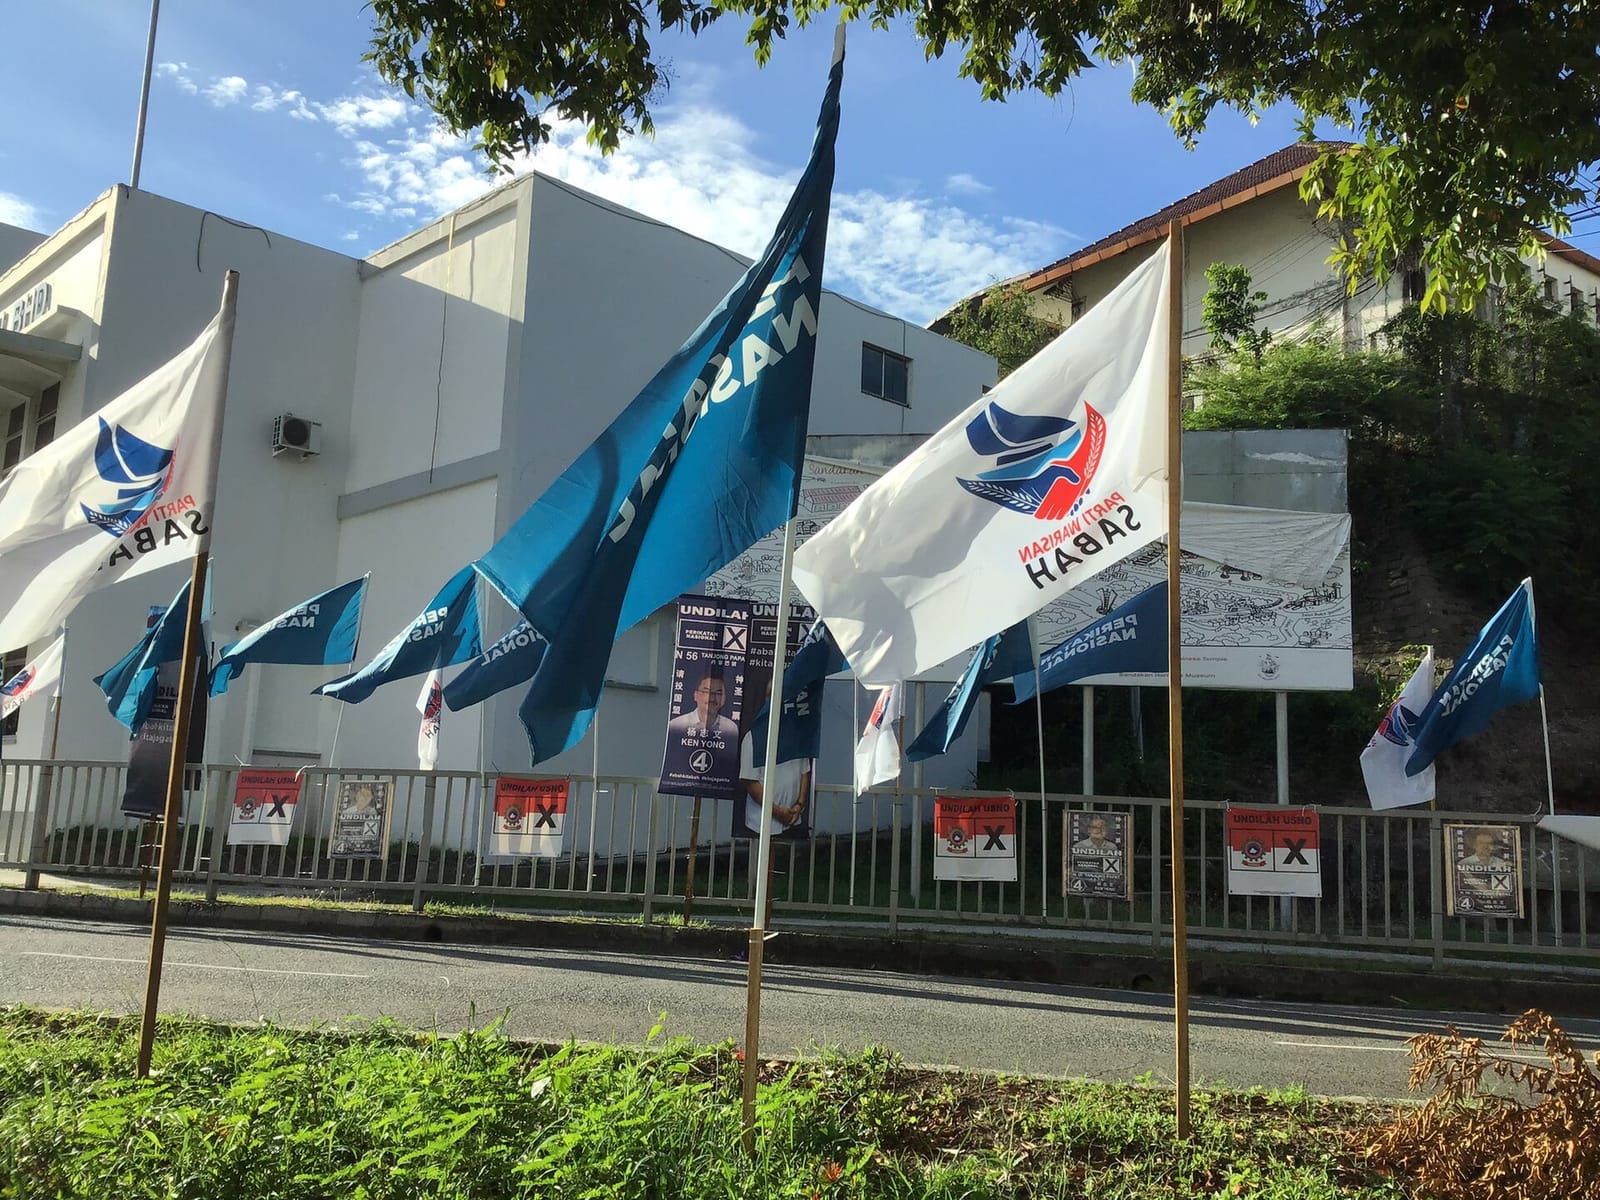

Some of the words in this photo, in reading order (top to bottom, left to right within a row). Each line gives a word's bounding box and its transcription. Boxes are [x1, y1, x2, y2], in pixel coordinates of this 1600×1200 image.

[685, 629, 719, 637] PERIKATAN
[686, 651, 699, 661] 56
[701, 652, 729, 660] TANJONG
[681, 738, 700, 748] KEN
[701, 739, 726, 750] YONG
[693, 751, 708, 771] 4
[500, 783, 538, 793] UNDILAH
[942, 803, 982, 813] UNDILAH
[1233, 815, 1280, 825] UNDILAH
[1283, 815, 1312, 825] USNO
[1071, 847, 1122, 856] UNDILAH
[1457, 864, 1512, 873] UNDILAH
